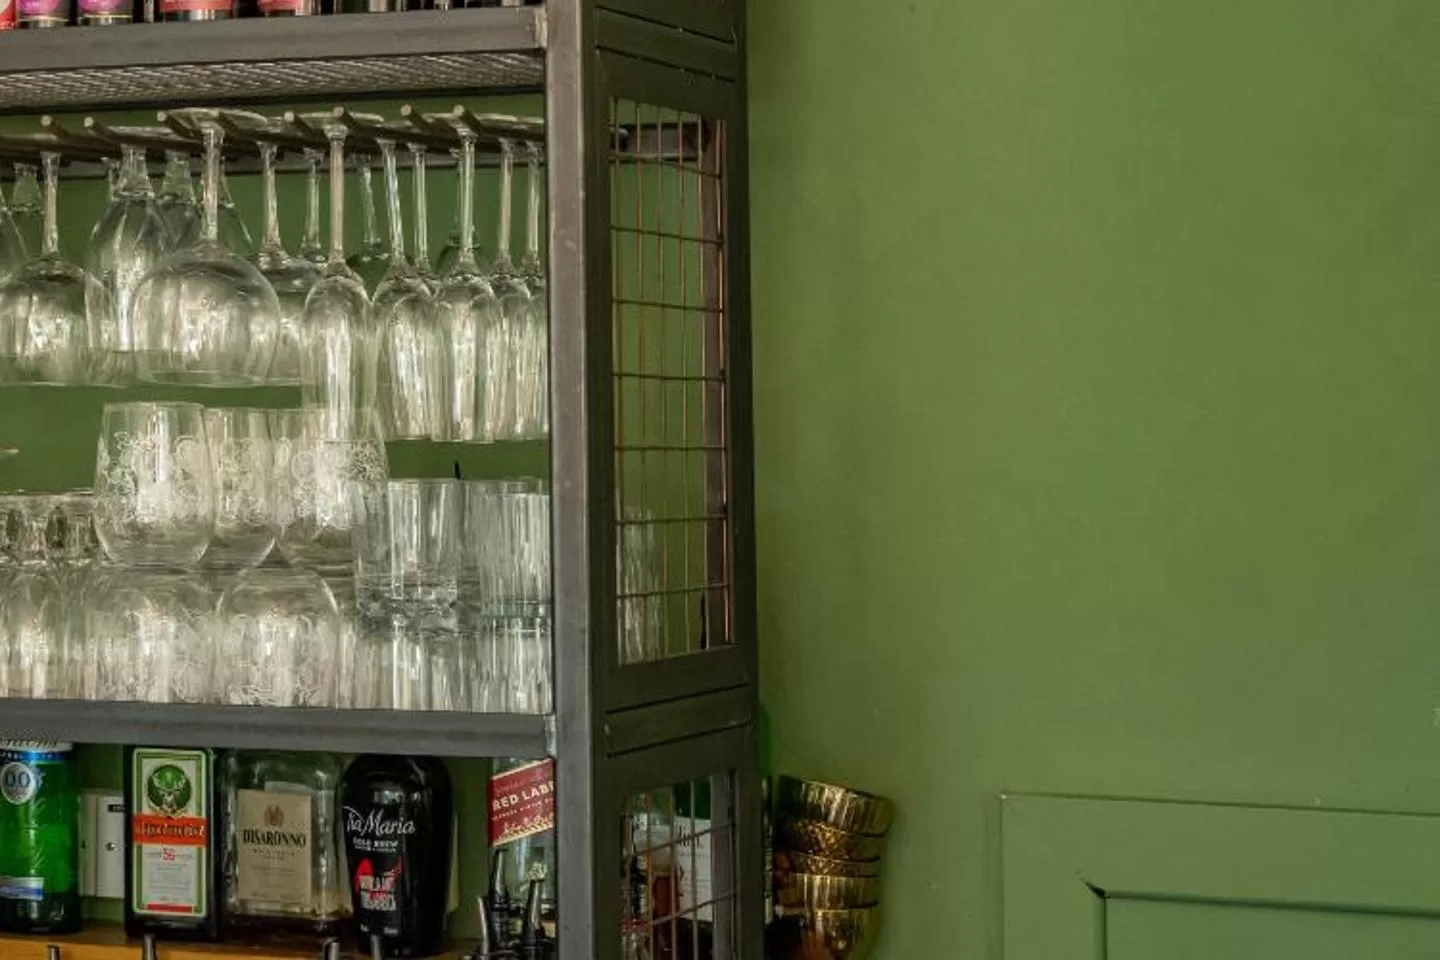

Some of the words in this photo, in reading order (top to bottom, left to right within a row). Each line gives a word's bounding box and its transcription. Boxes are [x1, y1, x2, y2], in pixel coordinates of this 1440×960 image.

[492, 793, 520, 812] RED
[366, 808, 416, 837] Maria
[242, 828, 307, 849] DISARONNO
